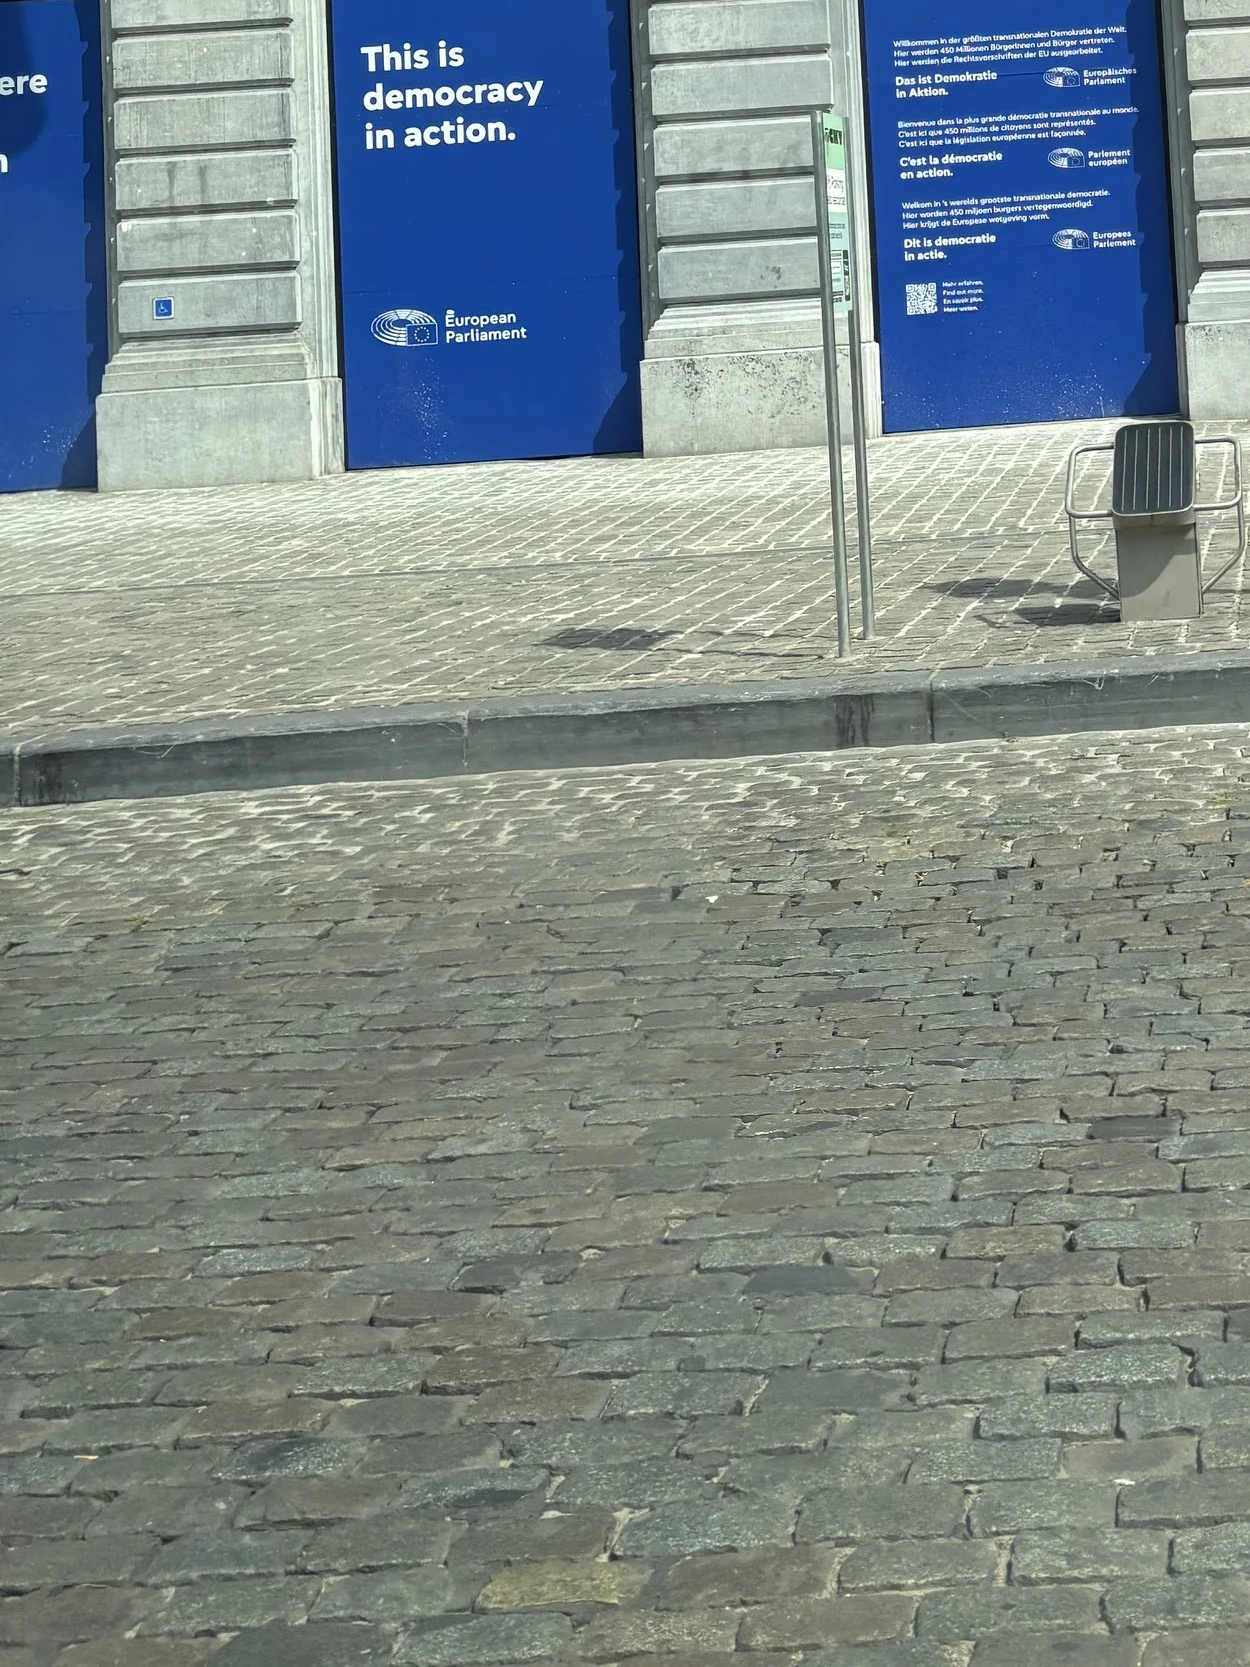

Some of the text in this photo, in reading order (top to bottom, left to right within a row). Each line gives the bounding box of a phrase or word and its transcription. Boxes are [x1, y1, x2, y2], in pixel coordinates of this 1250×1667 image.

[361, 41, 464, 72] This is
[895, 70, 997, 87] Das ist Demokratie
[1084, 67, 1137, 78] Europäisches
[1084, 77, 1126, 86] Parlament
[363, 80, 543, 112] democracy
[896, 86, 948, 99] in Aktion.
[365, 117, 516, 149] in action.
[900, 150, 1002, 167] C'est la démocratie
[1088, 149, 1131, 159] Parlement
[1088, 158, 1128, 168] européen
[900, 167, 953, 179] en action.
[904, 233, 996, 249] Dit is democratie
[1093, 231, 1131, 240] Europees
[1094, 239, 1136, 249] Parlement
[905, 248, 947, 261] in actie.
[445, 313, 517, 328] European
[446, 327, 527, 344] Parliament
